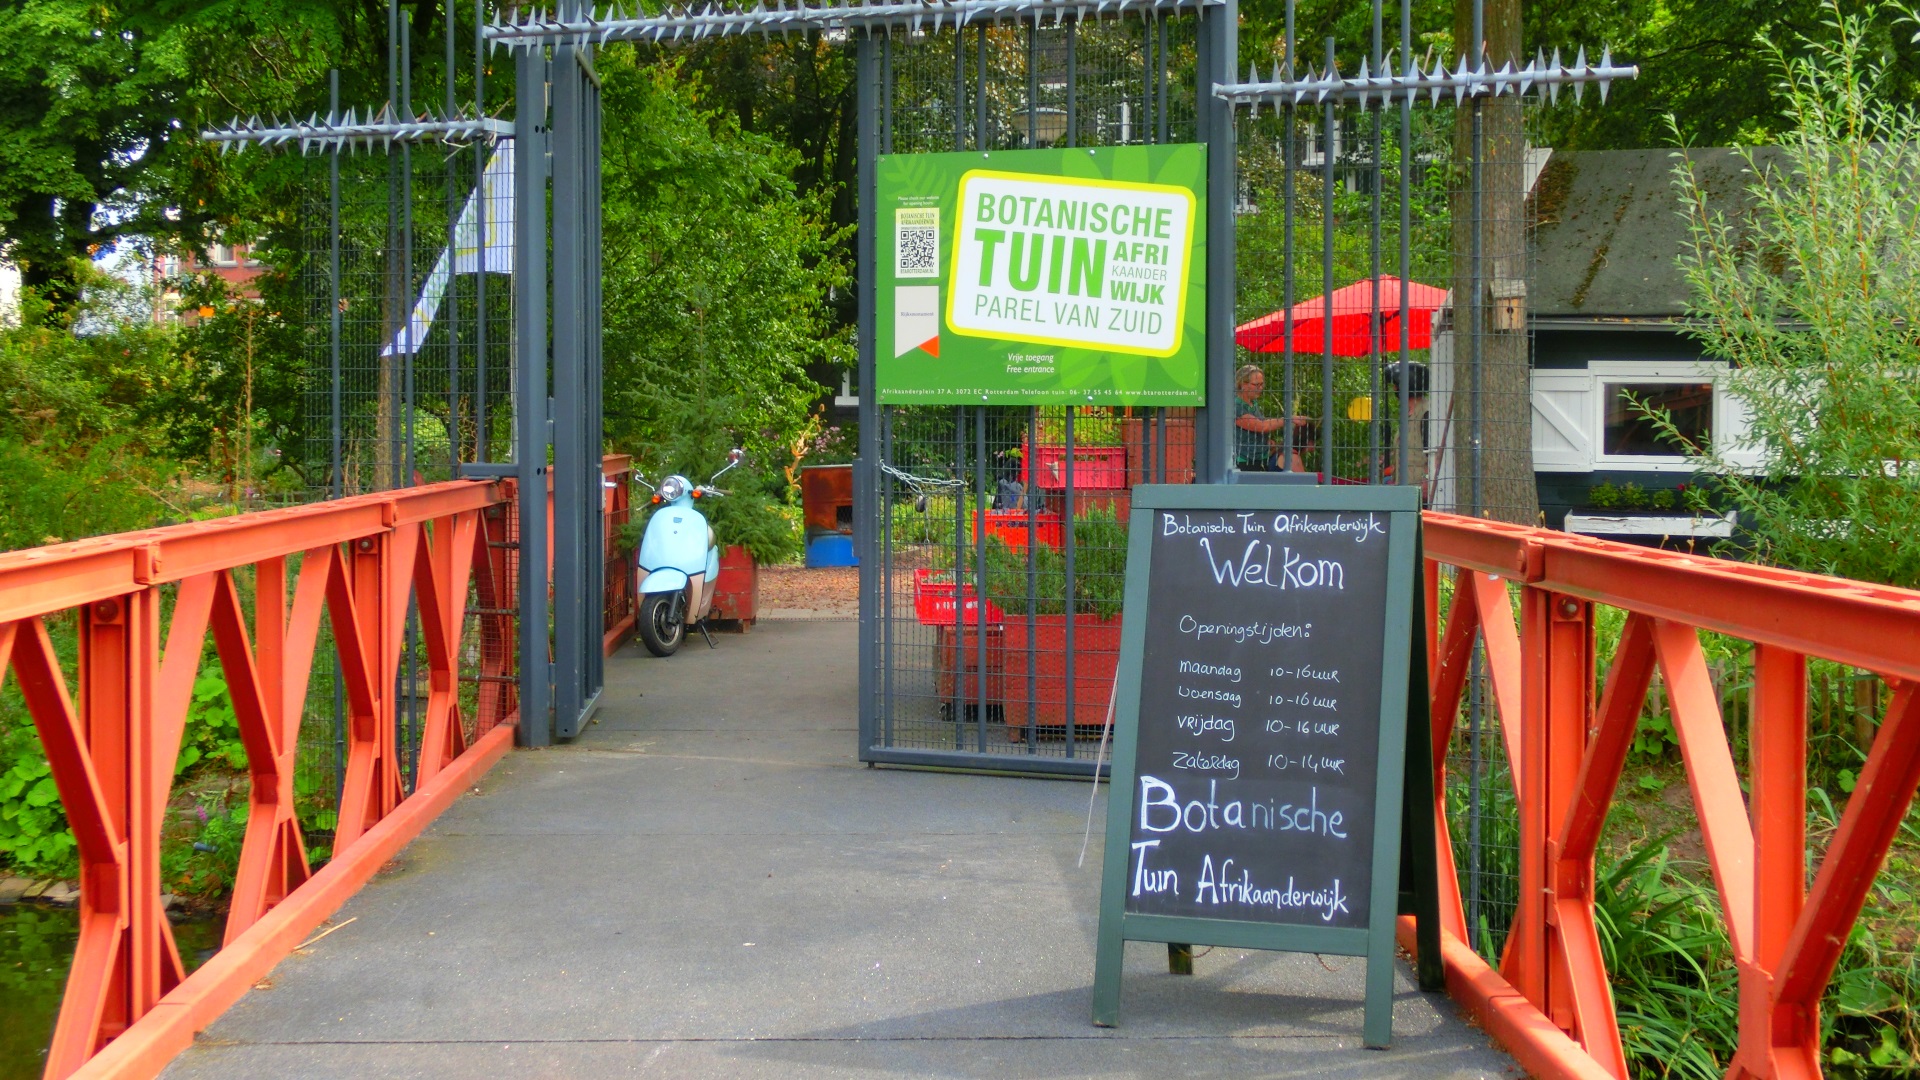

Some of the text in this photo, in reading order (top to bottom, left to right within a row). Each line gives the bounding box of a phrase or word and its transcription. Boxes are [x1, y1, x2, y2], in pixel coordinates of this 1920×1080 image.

[976, 192, 1173, 239] BOTANISCHE
[974, 227, 1107, 299] TUIN
[1113, 241, 1168, 266] AFRI
[1111, 265, 1167, 281] KAANDER
[1110, 280, 1165, 306] WIJK
[974, 294, 1163, 336] PAREL VAN ZUID
[1006, 353, 1054, 363] Vrije toegang
[1006, 364, 1055, 373] Free entrance
[1162, 512, 1236, 536] Botanische
[1237, 513, 1266, 534] Tuin
[1179, 614, 1312, 644] Openingstijden:
[1140, 776, 1348, 839] Botanische
[1132, 840, 1350, 921] Tuin Afrikaanderwijk
